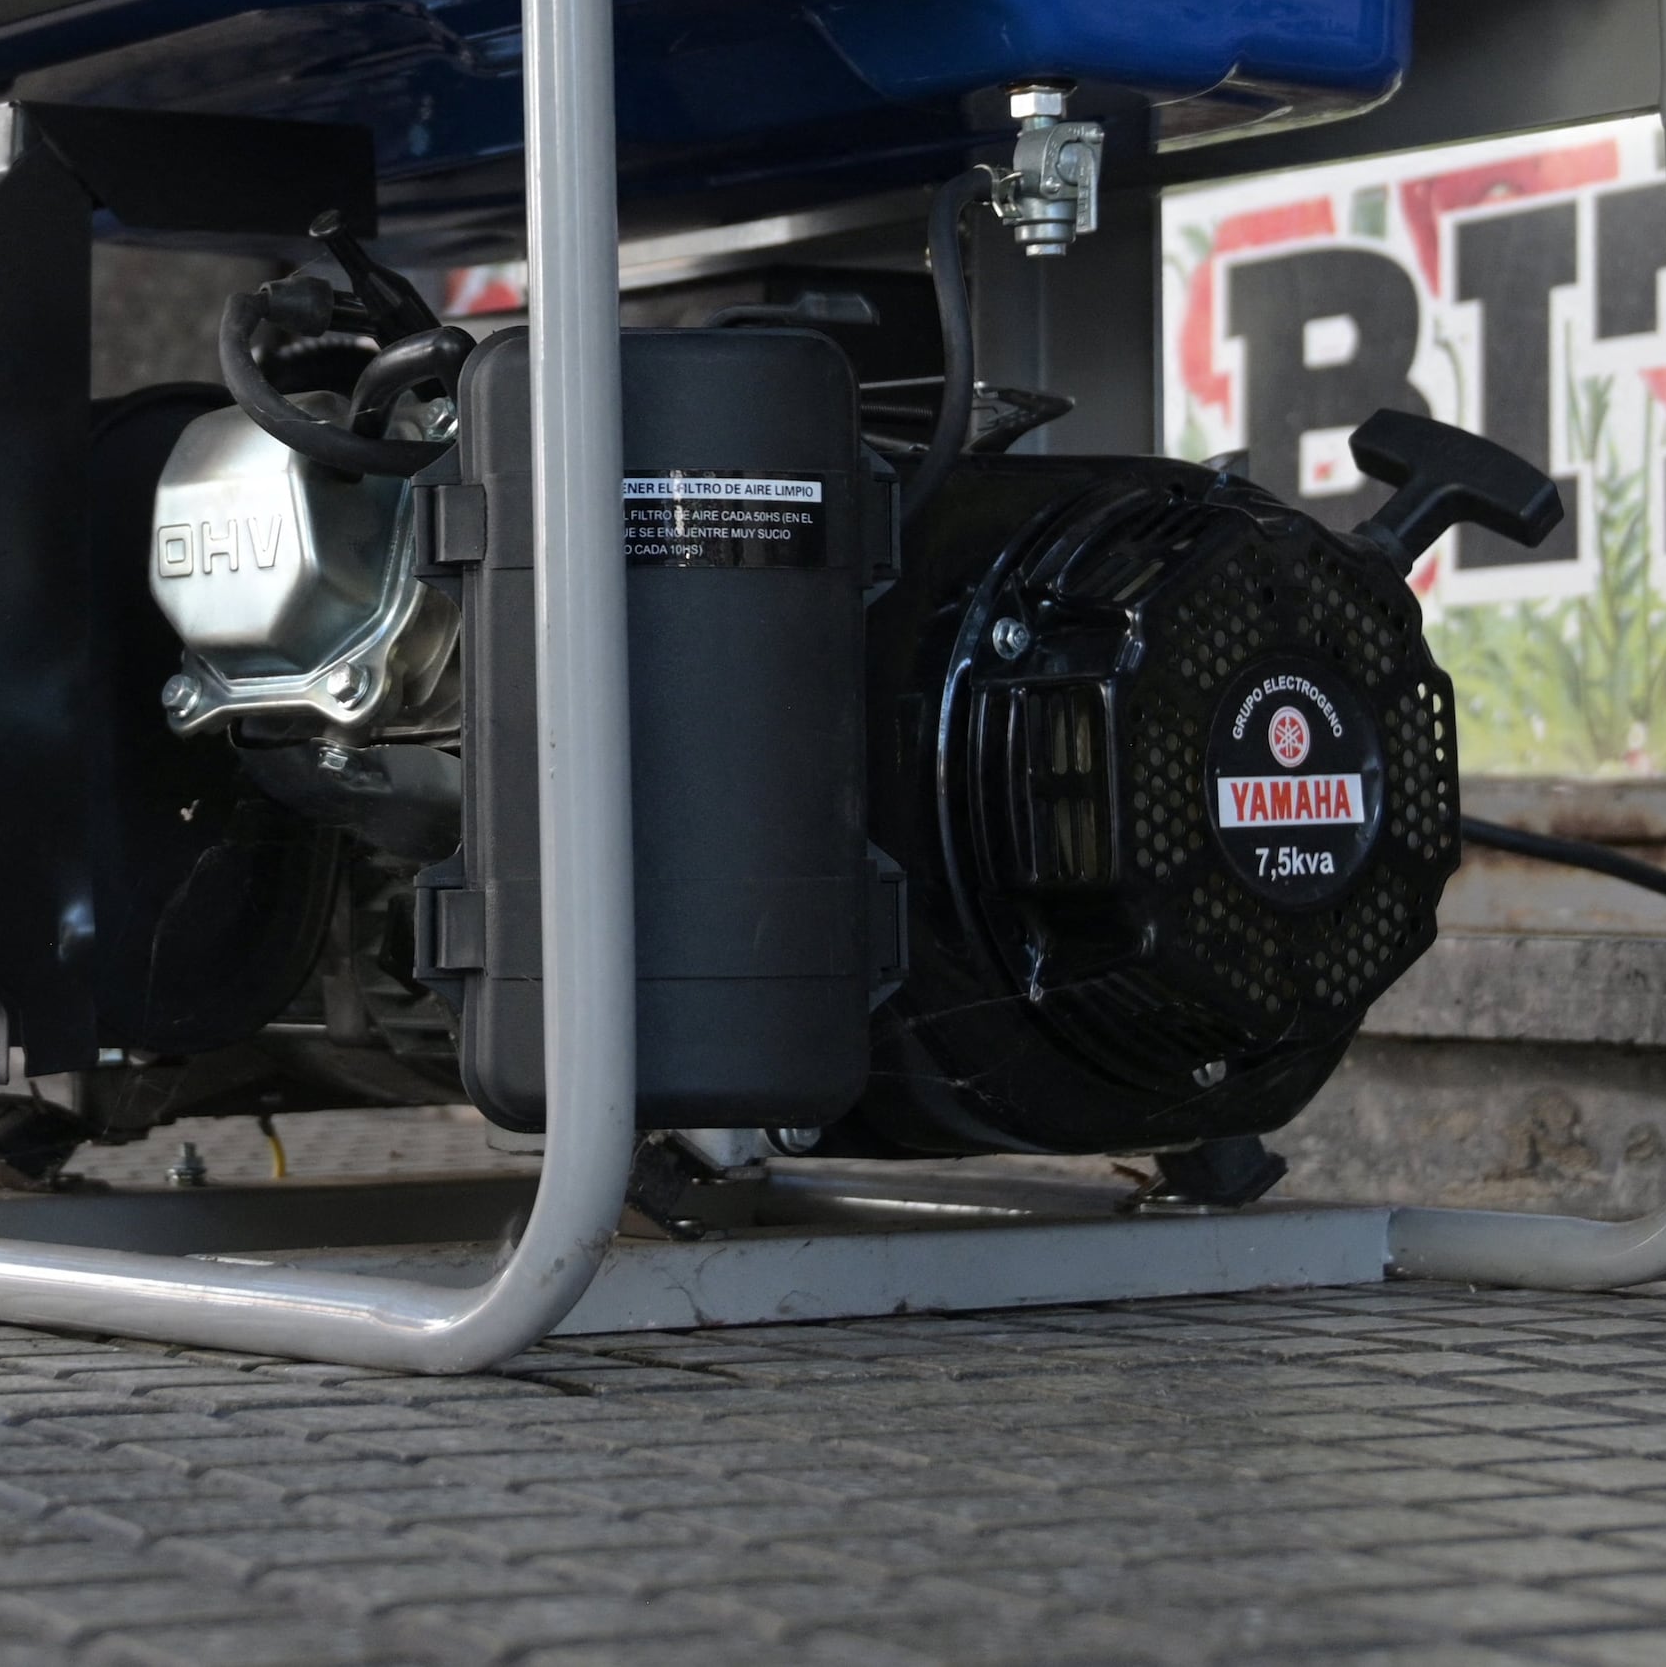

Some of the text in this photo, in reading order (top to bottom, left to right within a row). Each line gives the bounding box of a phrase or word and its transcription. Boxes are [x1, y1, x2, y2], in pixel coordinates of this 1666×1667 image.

[658, 483, 673, 495] EL
[676, 483, 722, 495] FILTRO
[725, 484, 741, 495] DE
[744, 484, 772, 496] AIRE
[775, 485, 814, 497] LIMPIO
[630, 510, 671, 521] FILTRO
[692, 511, 719, 522] AIRE
[721, 511, 753, 522] CADA
[753, 512, 781, 523] 50HS
[782, 512, 800, 525] (EN
[801, 513, 813, 524] EL
[157, 513, 284, 578] OHV
[638, 527, 654, 538] SE
[657, 527, 728, 539] ENCUENTRE
[731, 528, 757, 539] MUY
[757, 528, 791, 540] SUCIO
[634, 544, 668, 555] CADA
[1232, 675, 1344, 741] GRUPO ELECTROGENO
[1230, 779, 1352, 823] YAMAHA
[1255, 845, 1335, 882] 7,5kva
